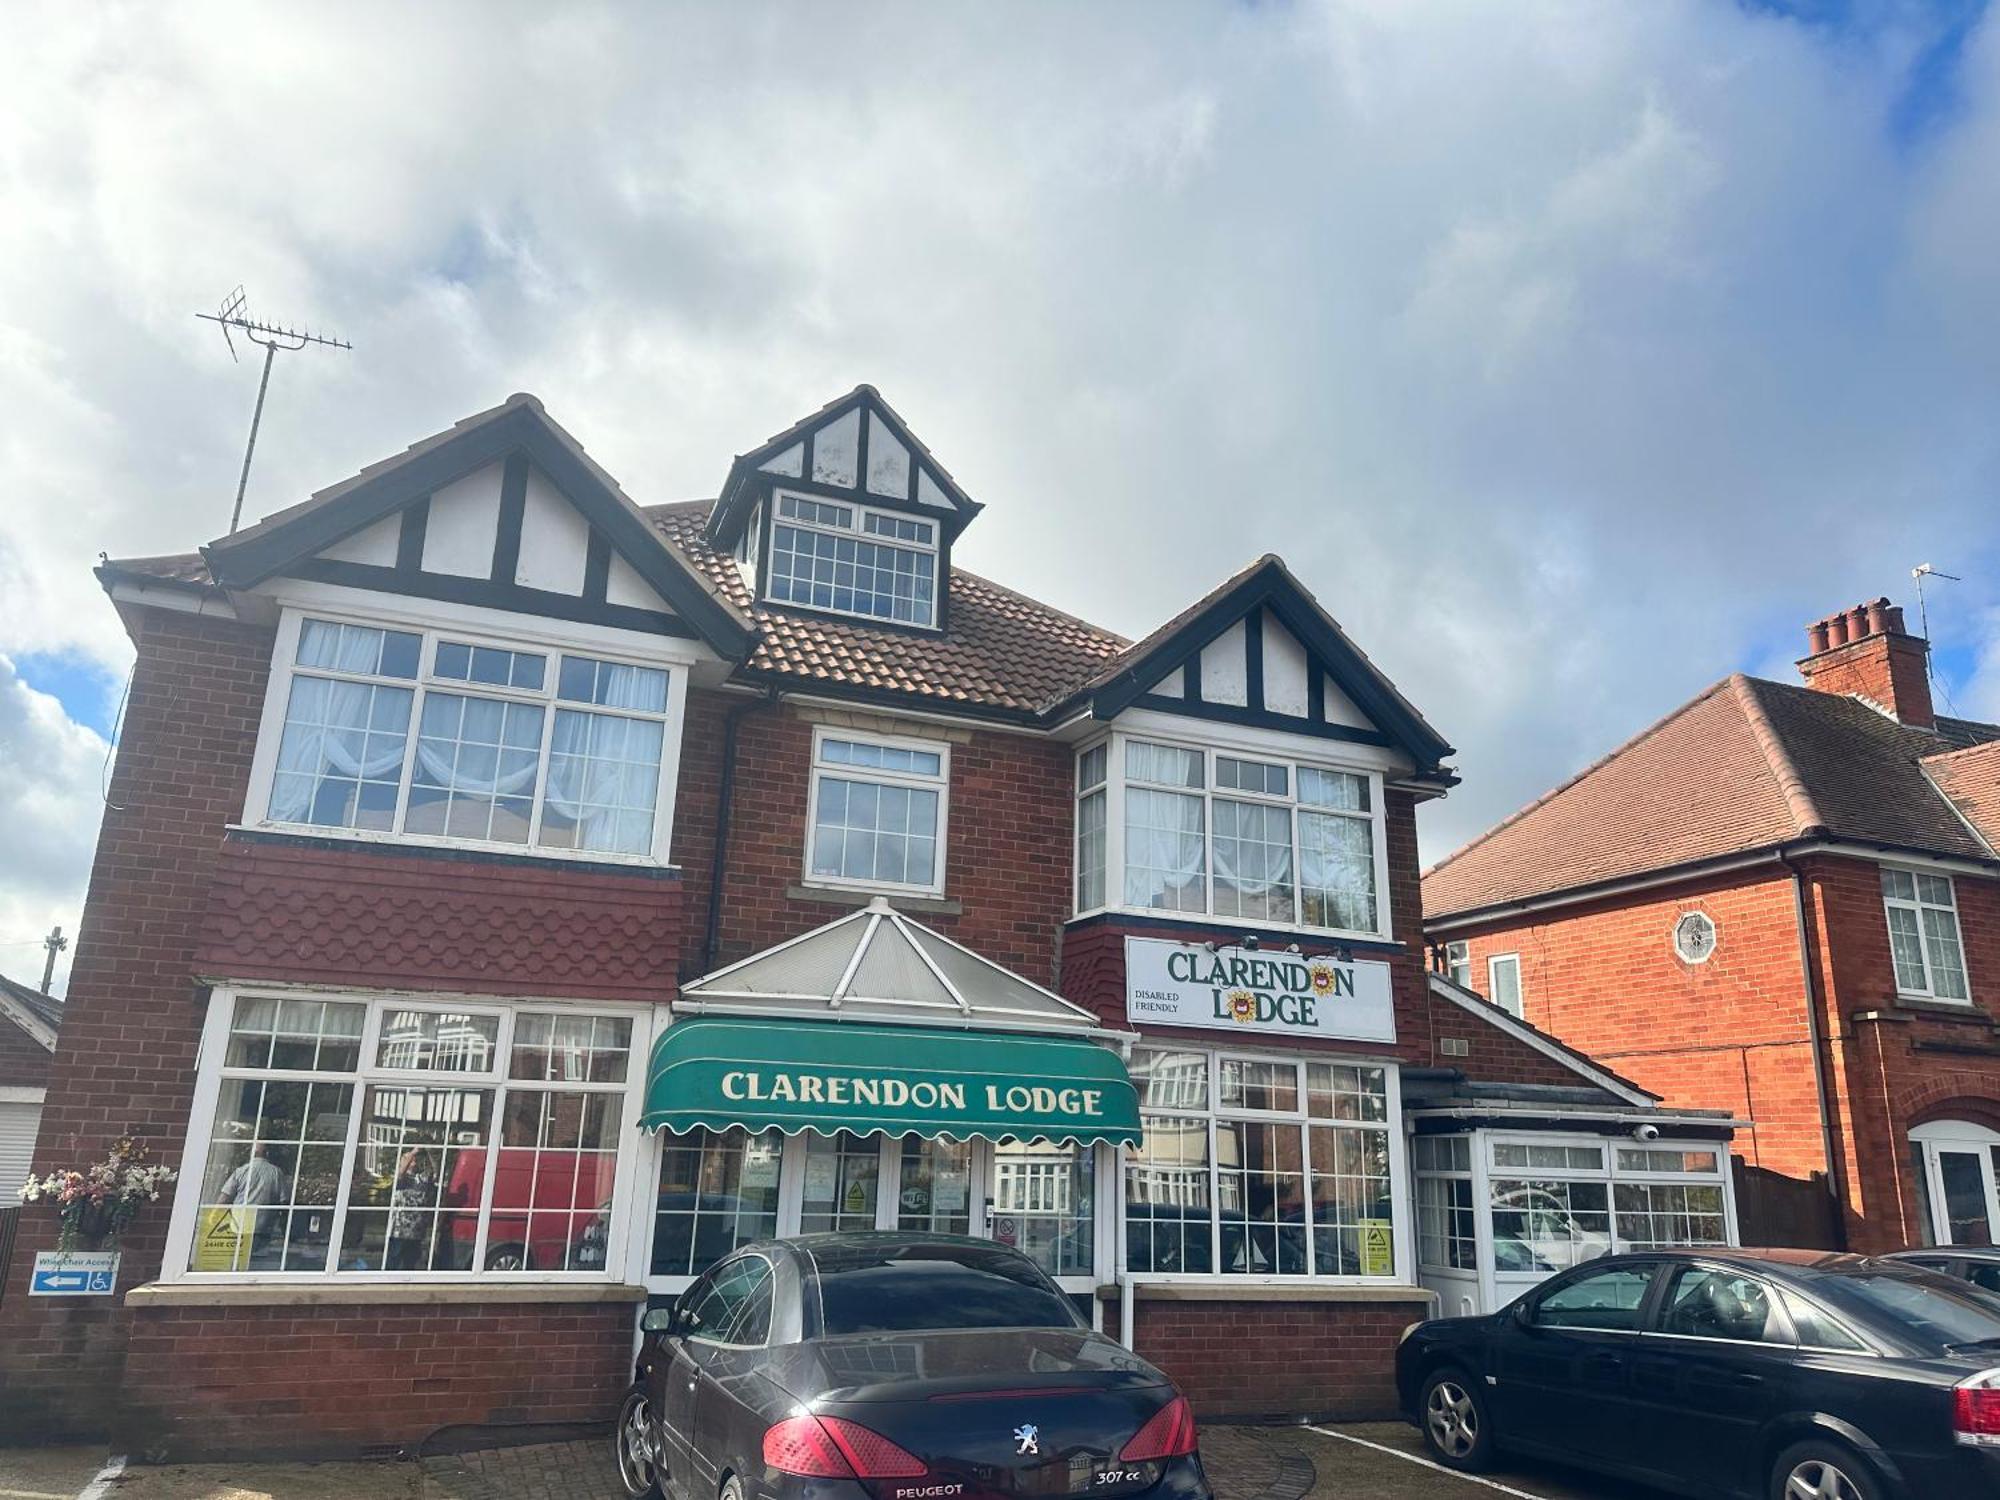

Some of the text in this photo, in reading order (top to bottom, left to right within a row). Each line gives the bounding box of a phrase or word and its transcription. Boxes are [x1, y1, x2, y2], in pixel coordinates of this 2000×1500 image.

[1135, 990, 1179, 1001] DISABLED
[1135, 1001, 1178, 1012] FRIENDLY
[721, 1071, 1104, 1115] CLARENDON LODGE
[1096, 1471, 1123, 1485] 307
[896, 1484, 963, 1499] PEUGEOT
